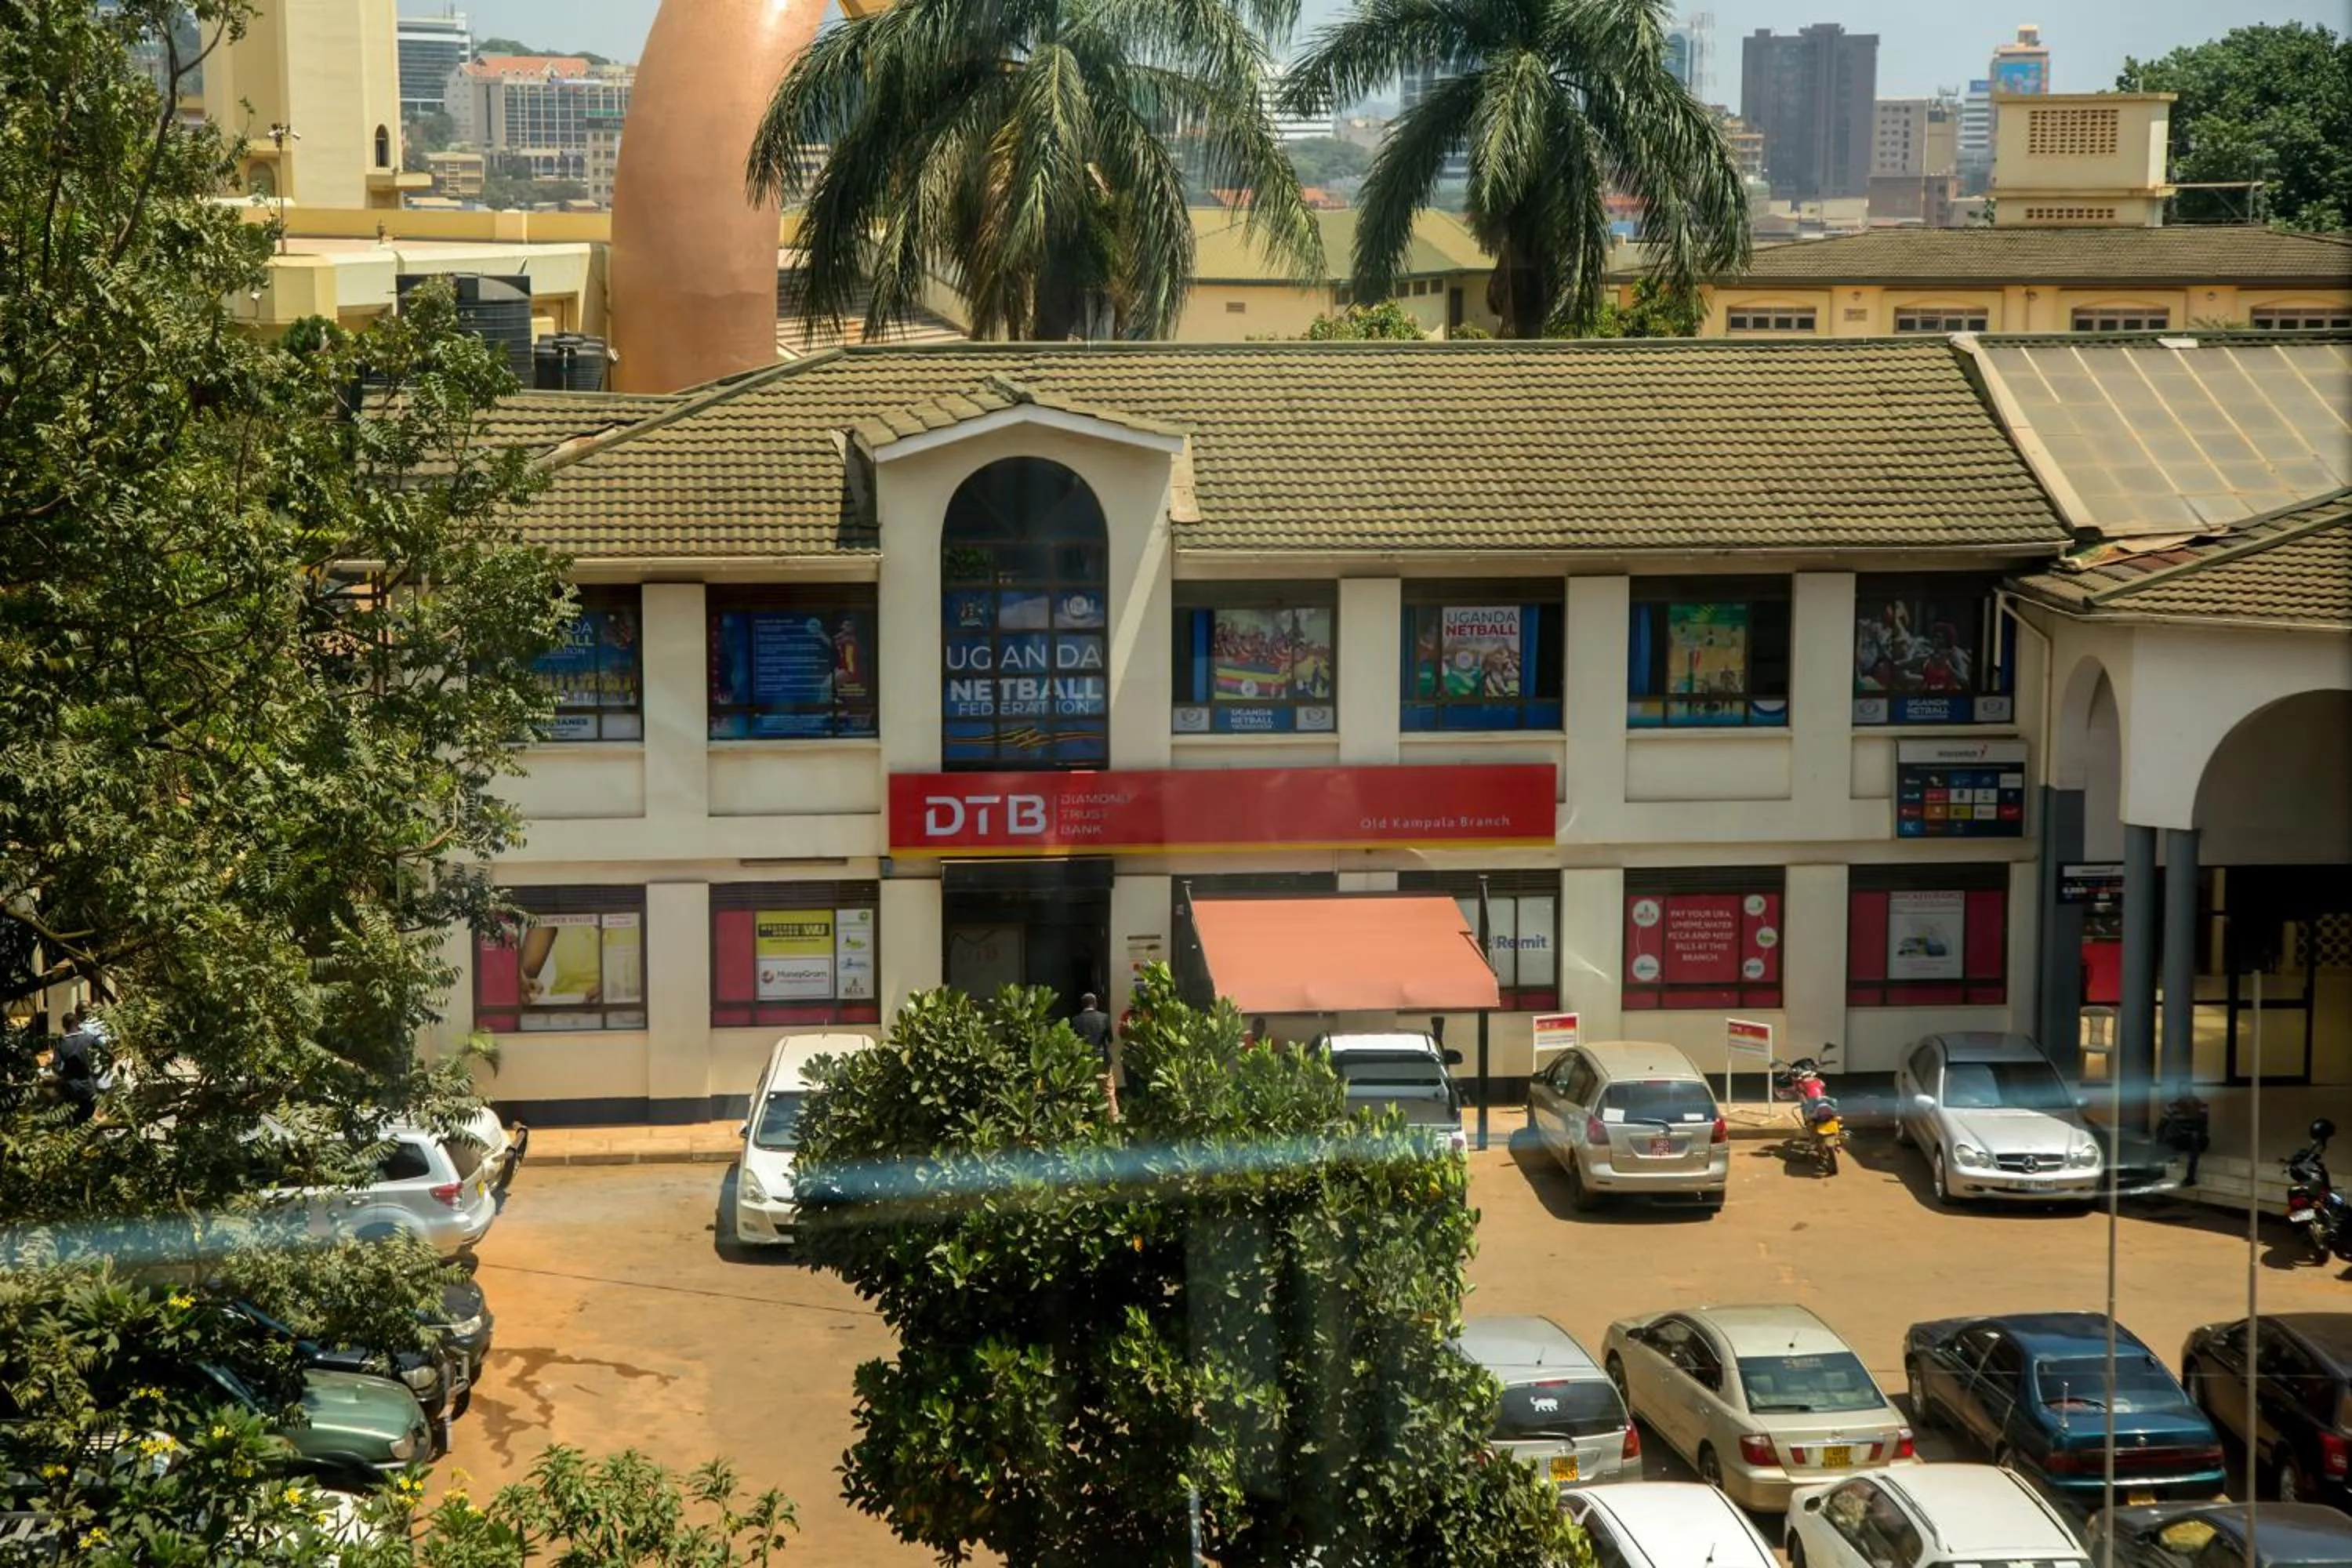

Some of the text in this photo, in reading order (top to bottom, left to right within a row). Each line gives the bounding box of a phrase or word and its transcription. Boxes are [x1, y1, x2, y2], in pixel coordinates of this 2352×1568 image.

[1446, 611, 1517, 623] UGANDA
[1445, 624, 1518, 636] NETBALL
[946, 644, 1102, 670] UGANDA
[950, 676, 1102, 702] NETBALL
[958, 701, 1091, 716] FEDERATION
[1060, 794, 1131, 804] DIAMOND
[925, 794, 1047, 836] DTB
[1060, 809, 1109, 819] TRUST
[1060, 825, 1103, 835] BANK
[1360, 815, 1510, 833] Old Kampala Branch
[1687, 909, 1711, 918] YOUR
